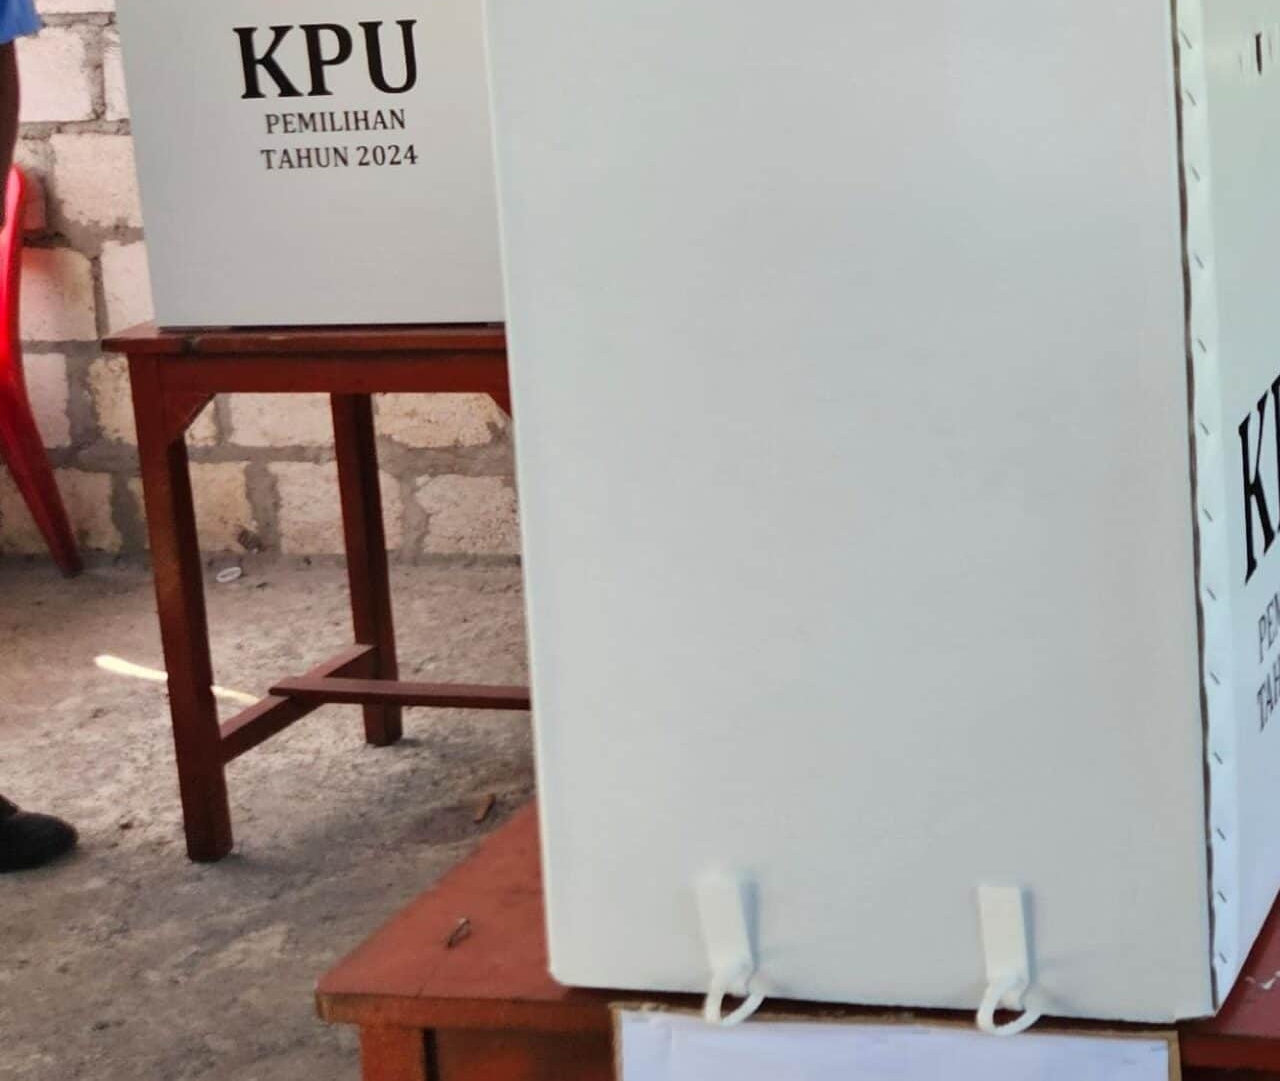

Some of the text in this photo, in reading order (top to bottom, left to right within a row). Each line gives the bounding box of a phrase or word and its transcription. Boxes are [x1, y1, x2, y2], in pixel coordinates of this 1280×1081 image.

[232, 19, 418, 99] KPU
[264, 109, 407, 134] PEMILIHAN
[260, 143, 419, 170] TAHUN 2024
